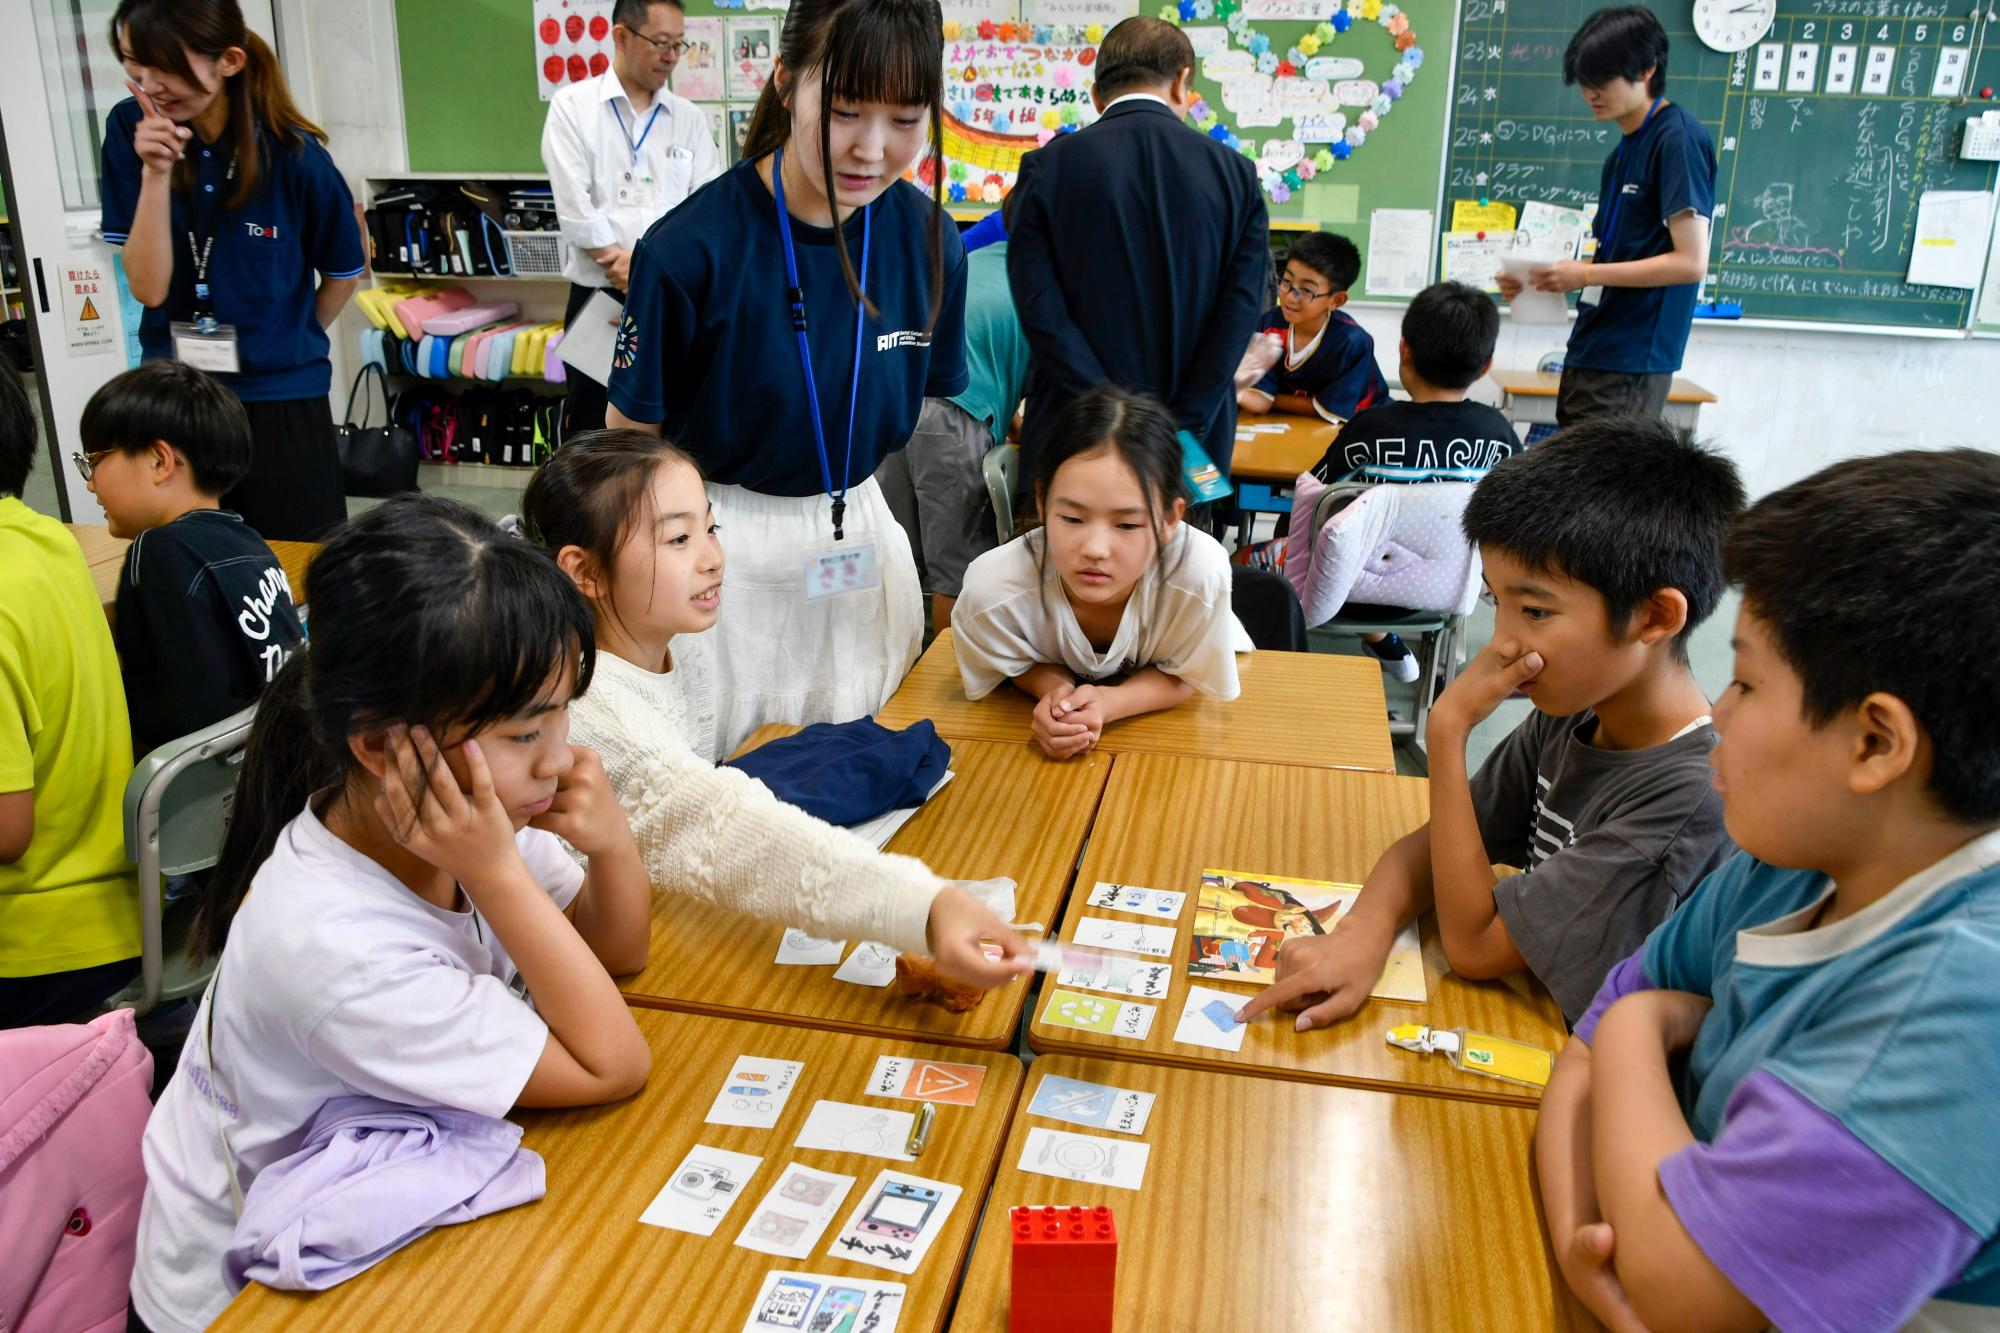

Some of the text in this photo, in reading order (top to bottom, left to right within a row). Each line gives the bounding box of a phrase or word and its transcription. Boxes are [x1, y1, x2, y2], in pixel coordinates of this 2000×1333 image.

[1464, 0, 1492, 21] 22
[1770, 22, 1966, 42] 1 2 3 4 5 6
[1463, 42, 1485, 61] 23
[1487, 44, 1502, 59] 火
[1459, 85, 1497, 105] 24 水
[1453, 127, 1478, 147] 25
[1480, 131, 1493, 145] 木
[1451, 167, 1474, 186] 26
[877, 331, 900, 352] AIT
[880, 1060, 901, 1092] きけんごみ
[1118, 1094, 1140, 1130] もえないごみ
